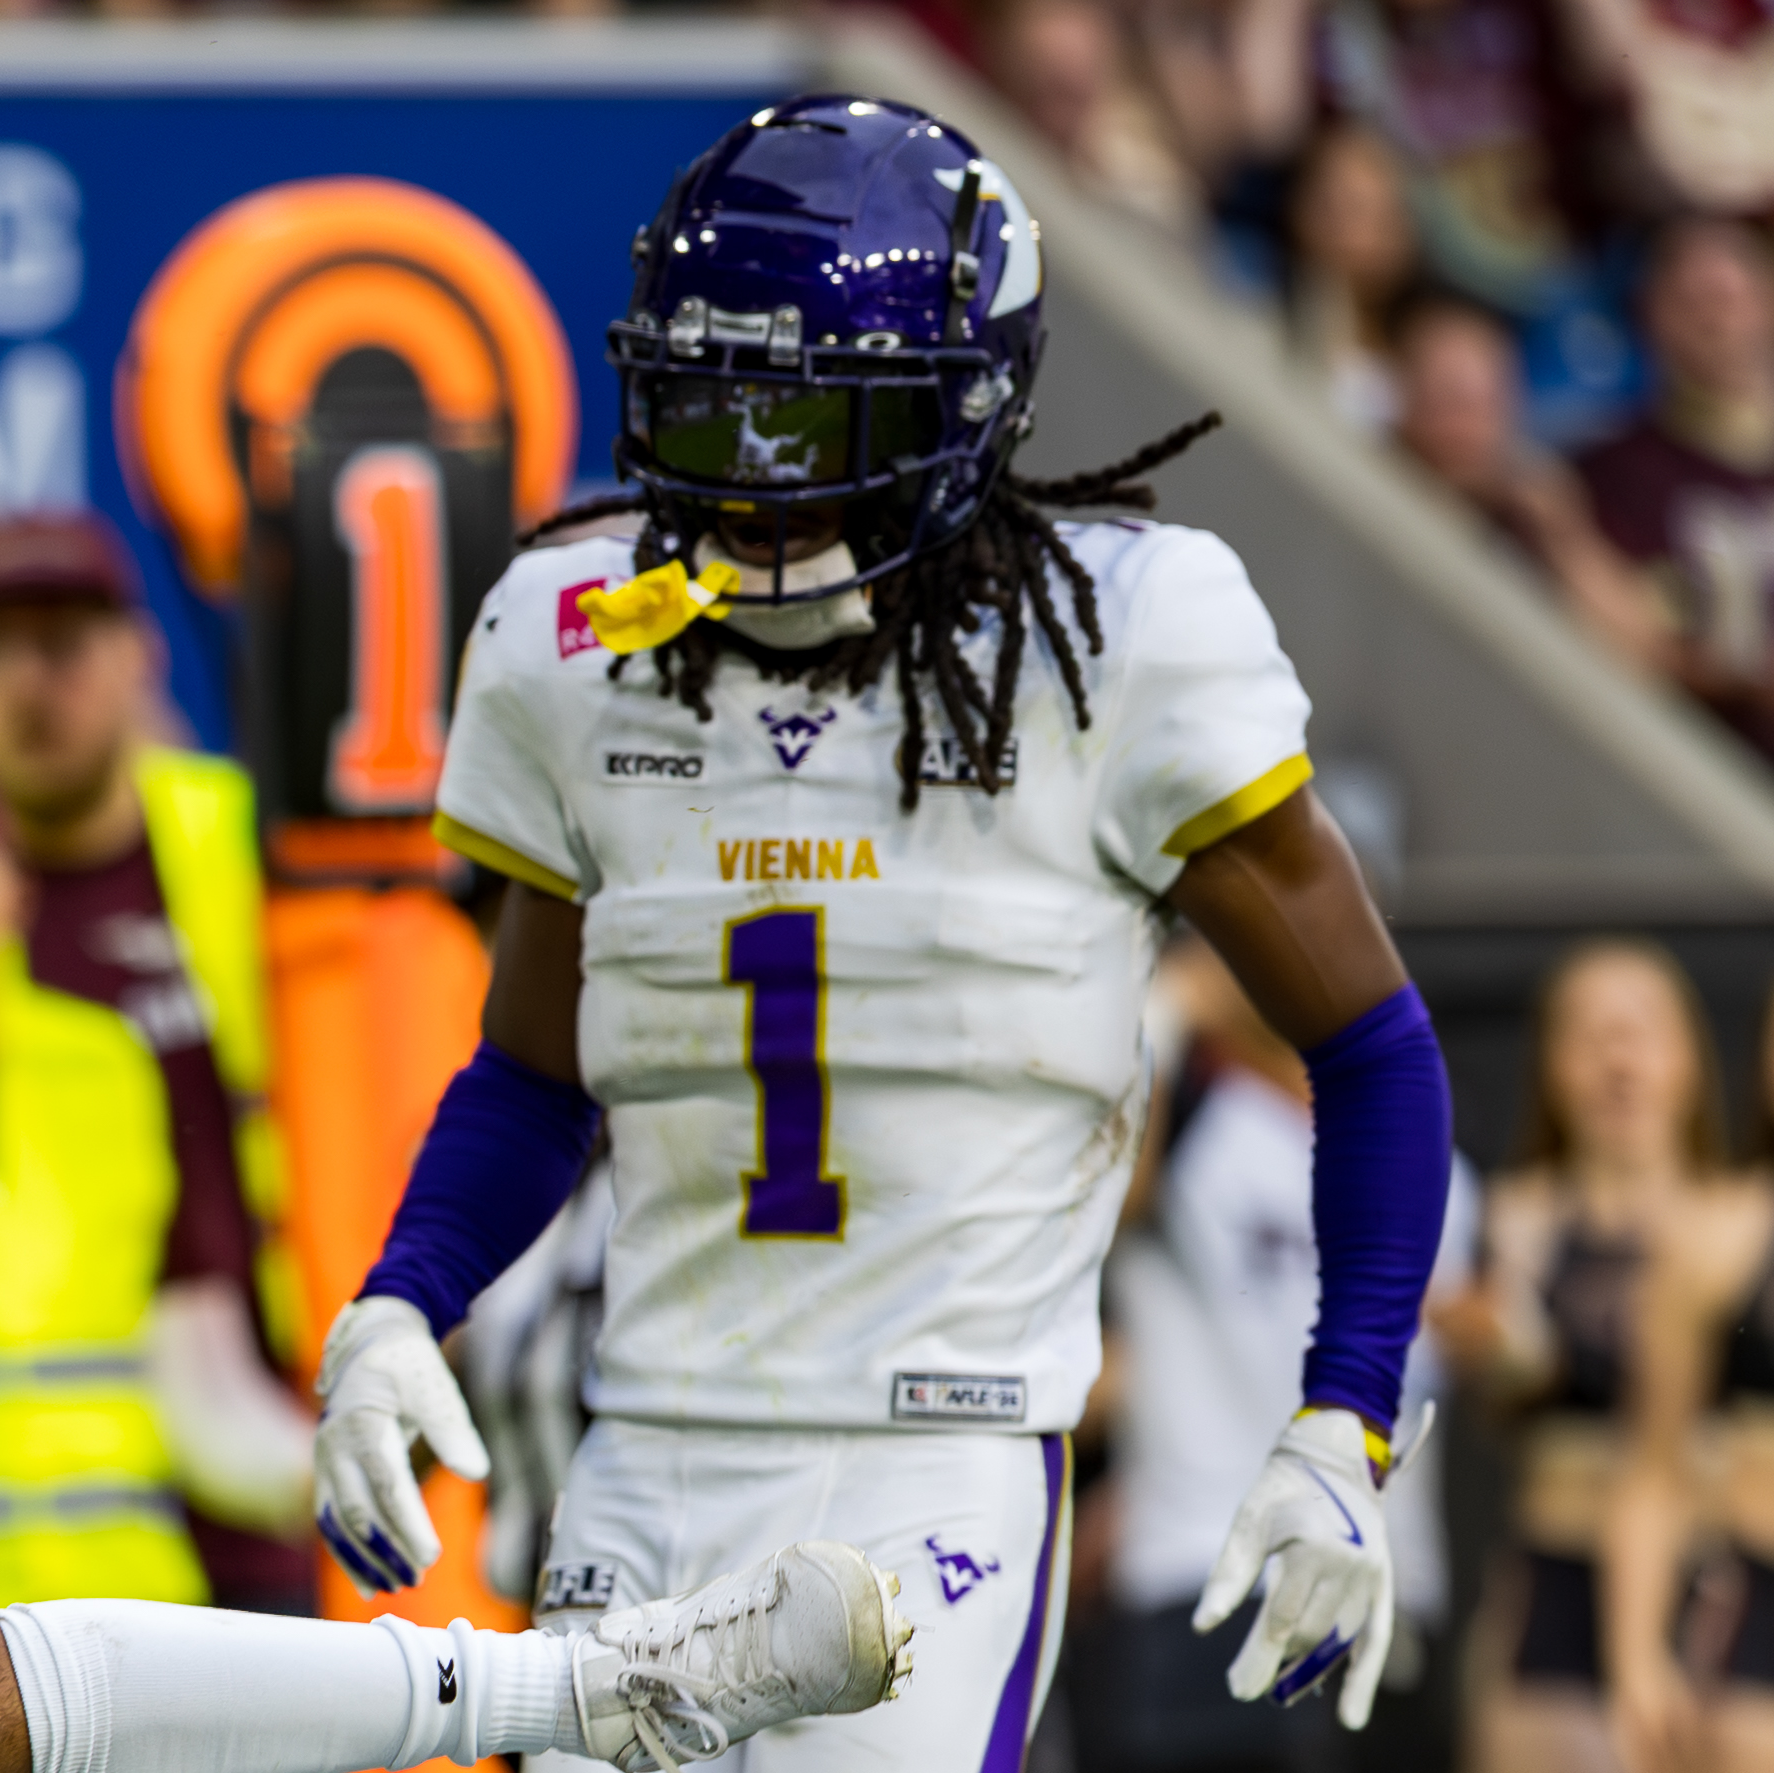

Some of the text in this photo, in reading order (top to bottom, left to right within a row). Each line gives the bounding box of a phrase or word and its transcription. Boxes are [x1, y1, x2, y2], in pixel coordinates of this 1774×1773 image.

[336, 445, 445, 807] 1
[717, 837, 880, 881] VIENNA
[721, 904, 847, 1241] 1
